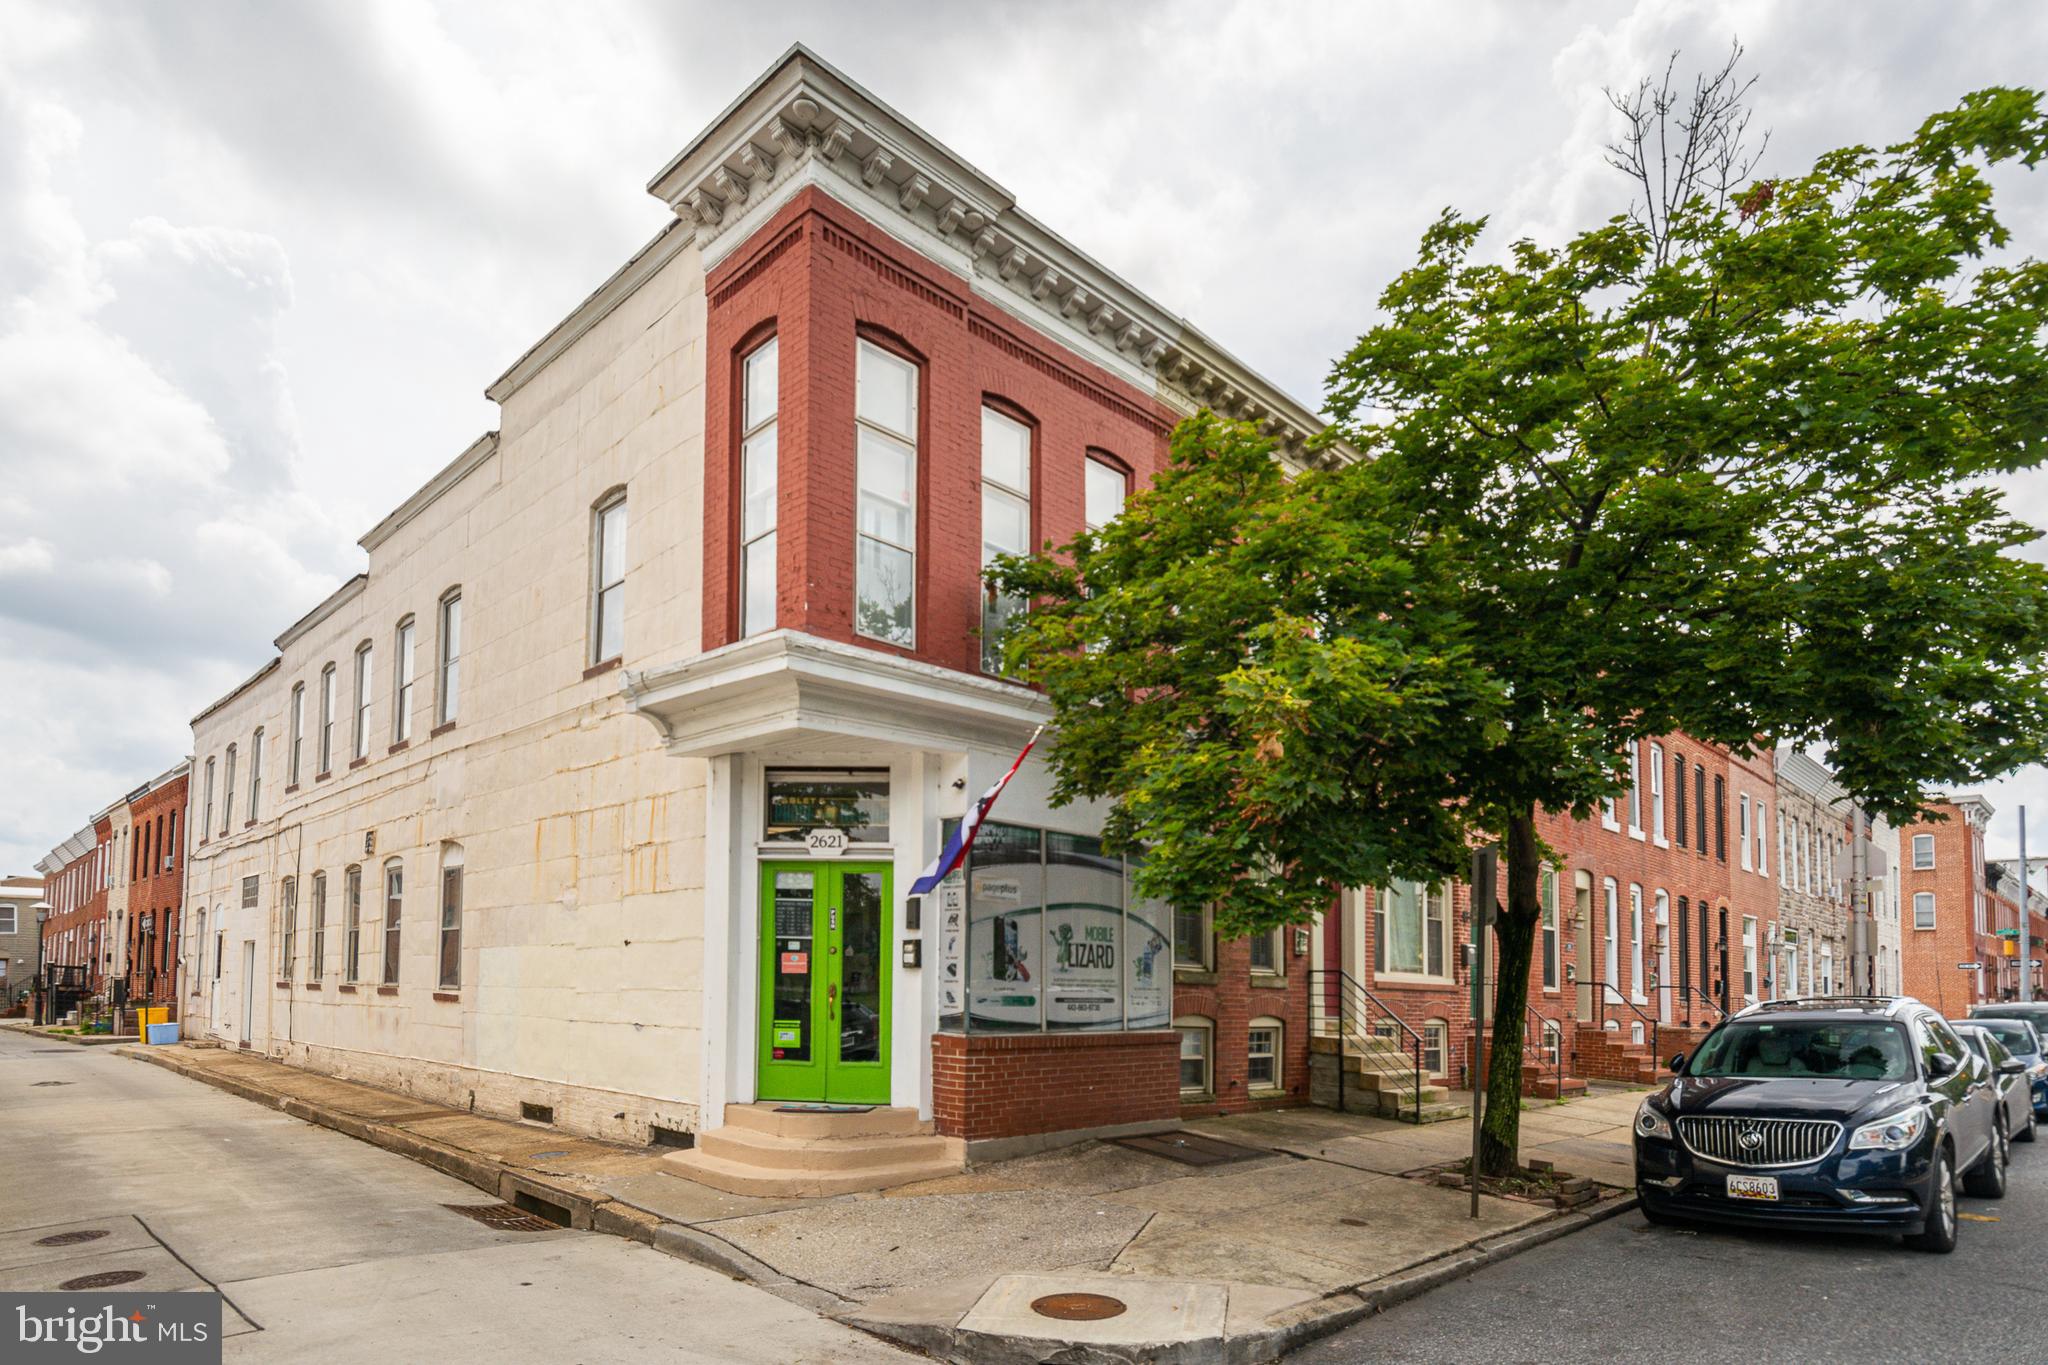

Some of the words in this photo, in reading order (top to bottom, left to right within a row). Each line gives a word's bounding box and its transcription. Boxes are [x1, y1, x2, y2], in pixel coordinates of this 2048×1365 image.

[810, 835, 842, 848] 2621
[1085, 926, 1114, 942] MOBILE
[1068, 943, 1114, 969] LIZARD
[1730, 1181, 1775, 1194] 6CS8603
